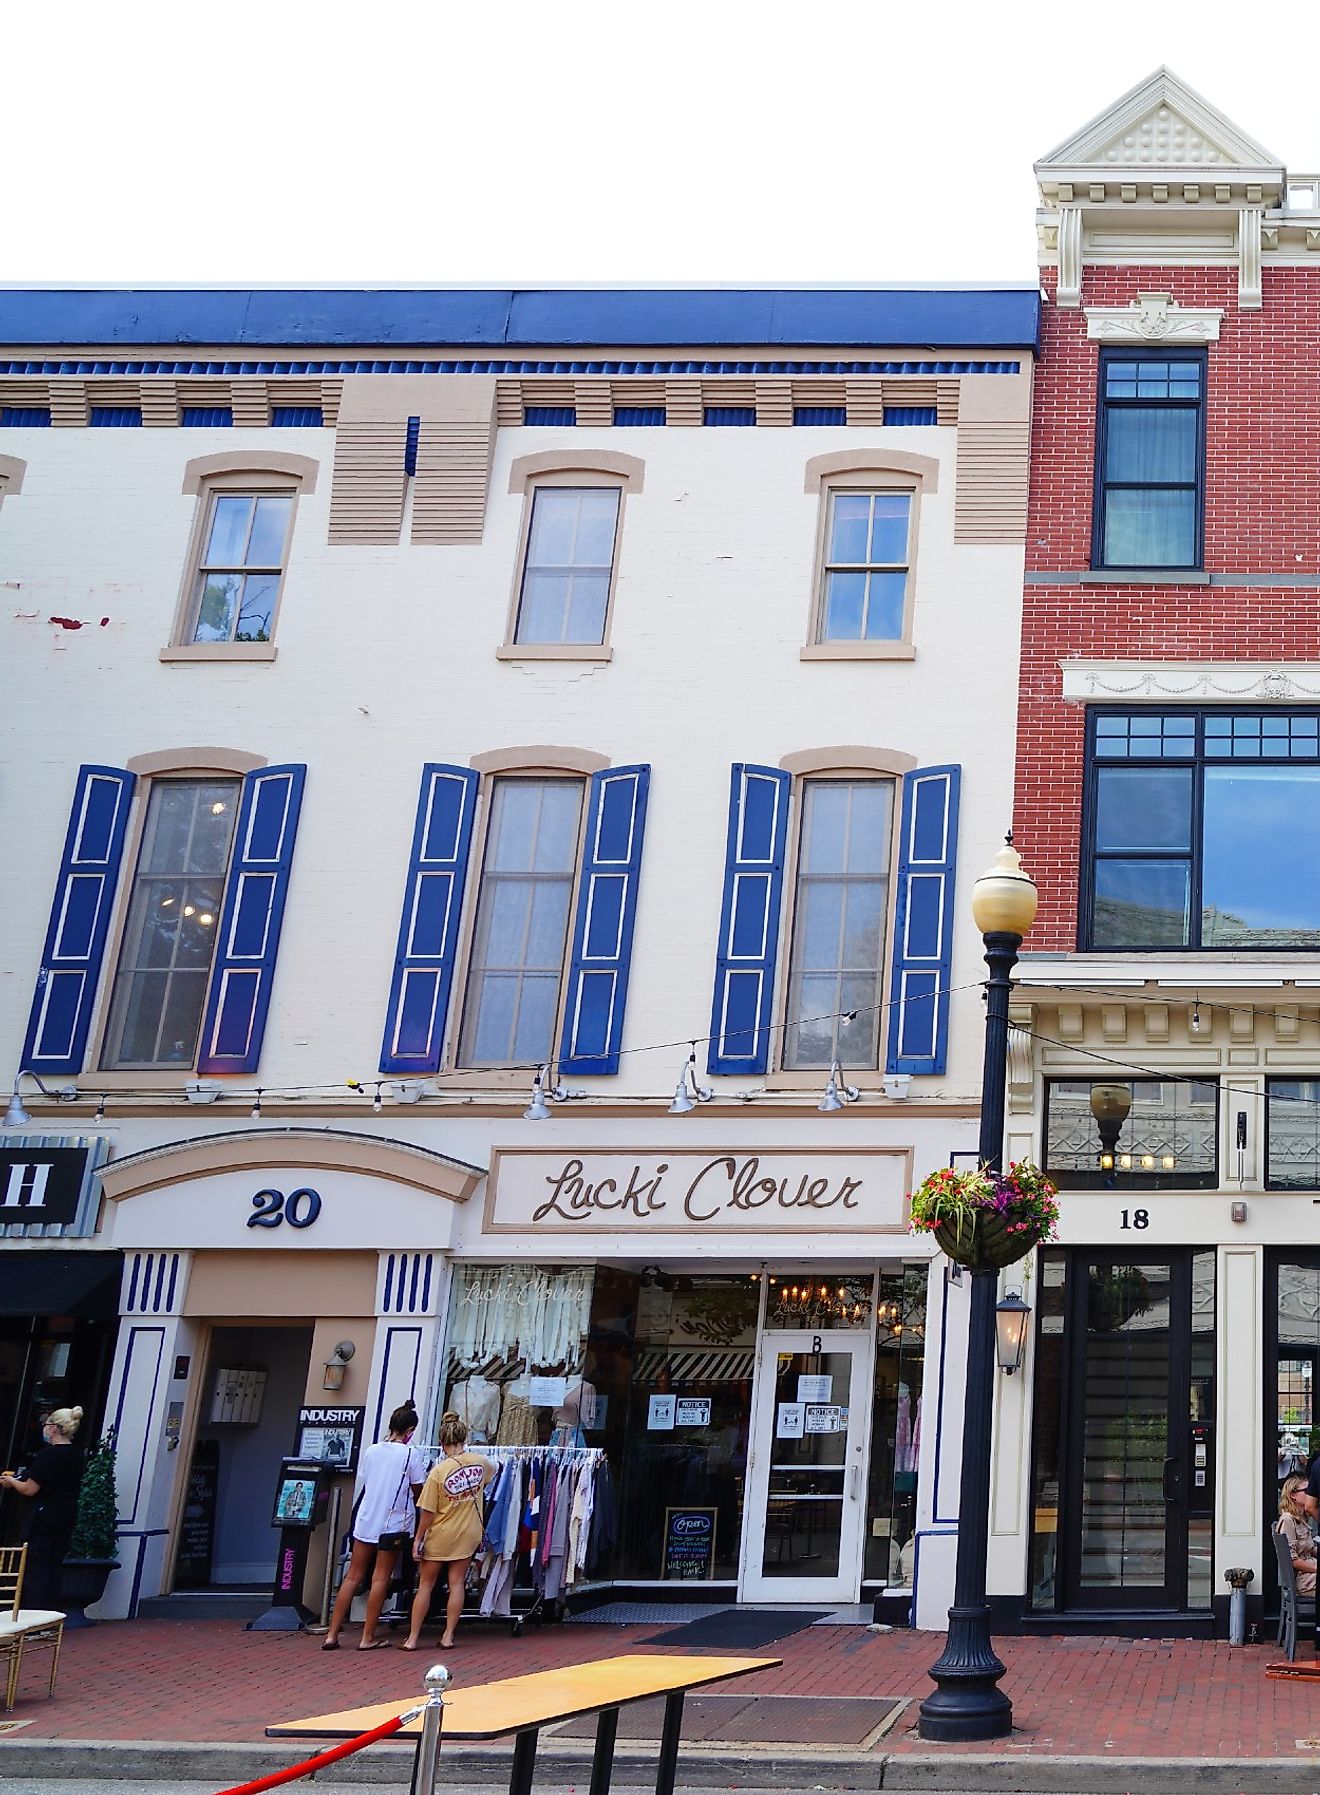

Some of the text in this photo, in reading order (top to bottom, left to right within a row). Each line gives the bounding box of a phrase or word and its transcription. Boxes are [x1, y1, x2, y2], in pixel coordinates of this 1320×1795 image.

[1, 1164, 54, 1207] H
[533, 1157, 862, 1221] Lucki Clover
[247, 1188, 322, 1228] 20
[1120, 1209, 1149, 1229] 18
[812, 1335, 822, 1354] B
[300, 1409, 361, 1422] INDUSTRY
[811, 1408, 836, 1416] NOTICE
[281, 1548, 295, 1590] INDUSTRY
